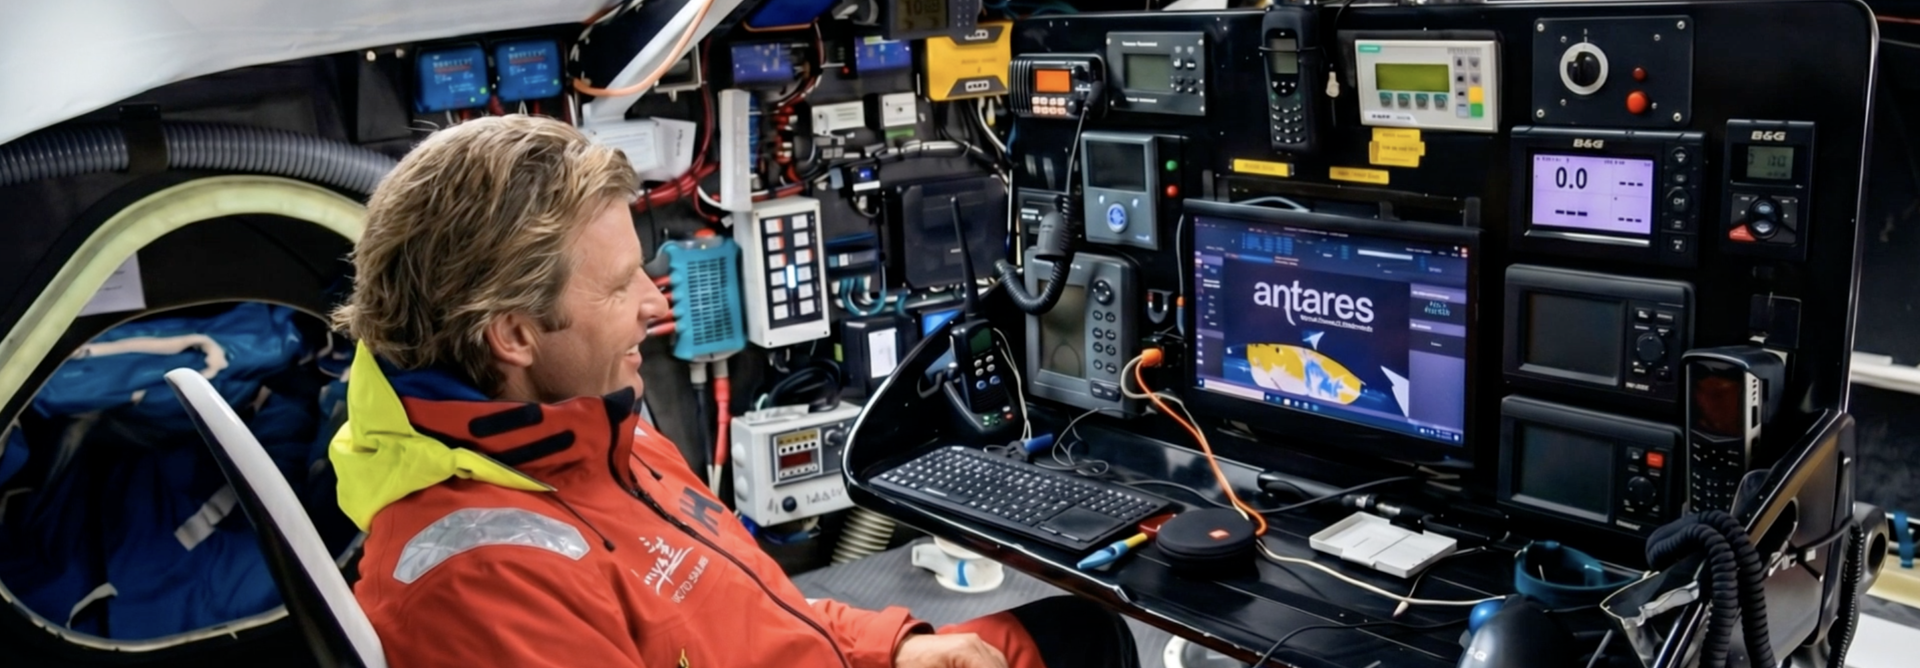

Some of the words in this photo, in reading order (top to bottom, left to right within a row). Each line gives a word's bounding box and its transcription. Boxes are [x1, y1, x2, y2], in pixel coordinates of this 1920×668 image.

[1573, 138, 1604, 149] B&G
[1751, 130, 1786, 141] B&G
[1555, 166, 1588, 190] 0.0
[1253, 280, 1375, 326] antares
